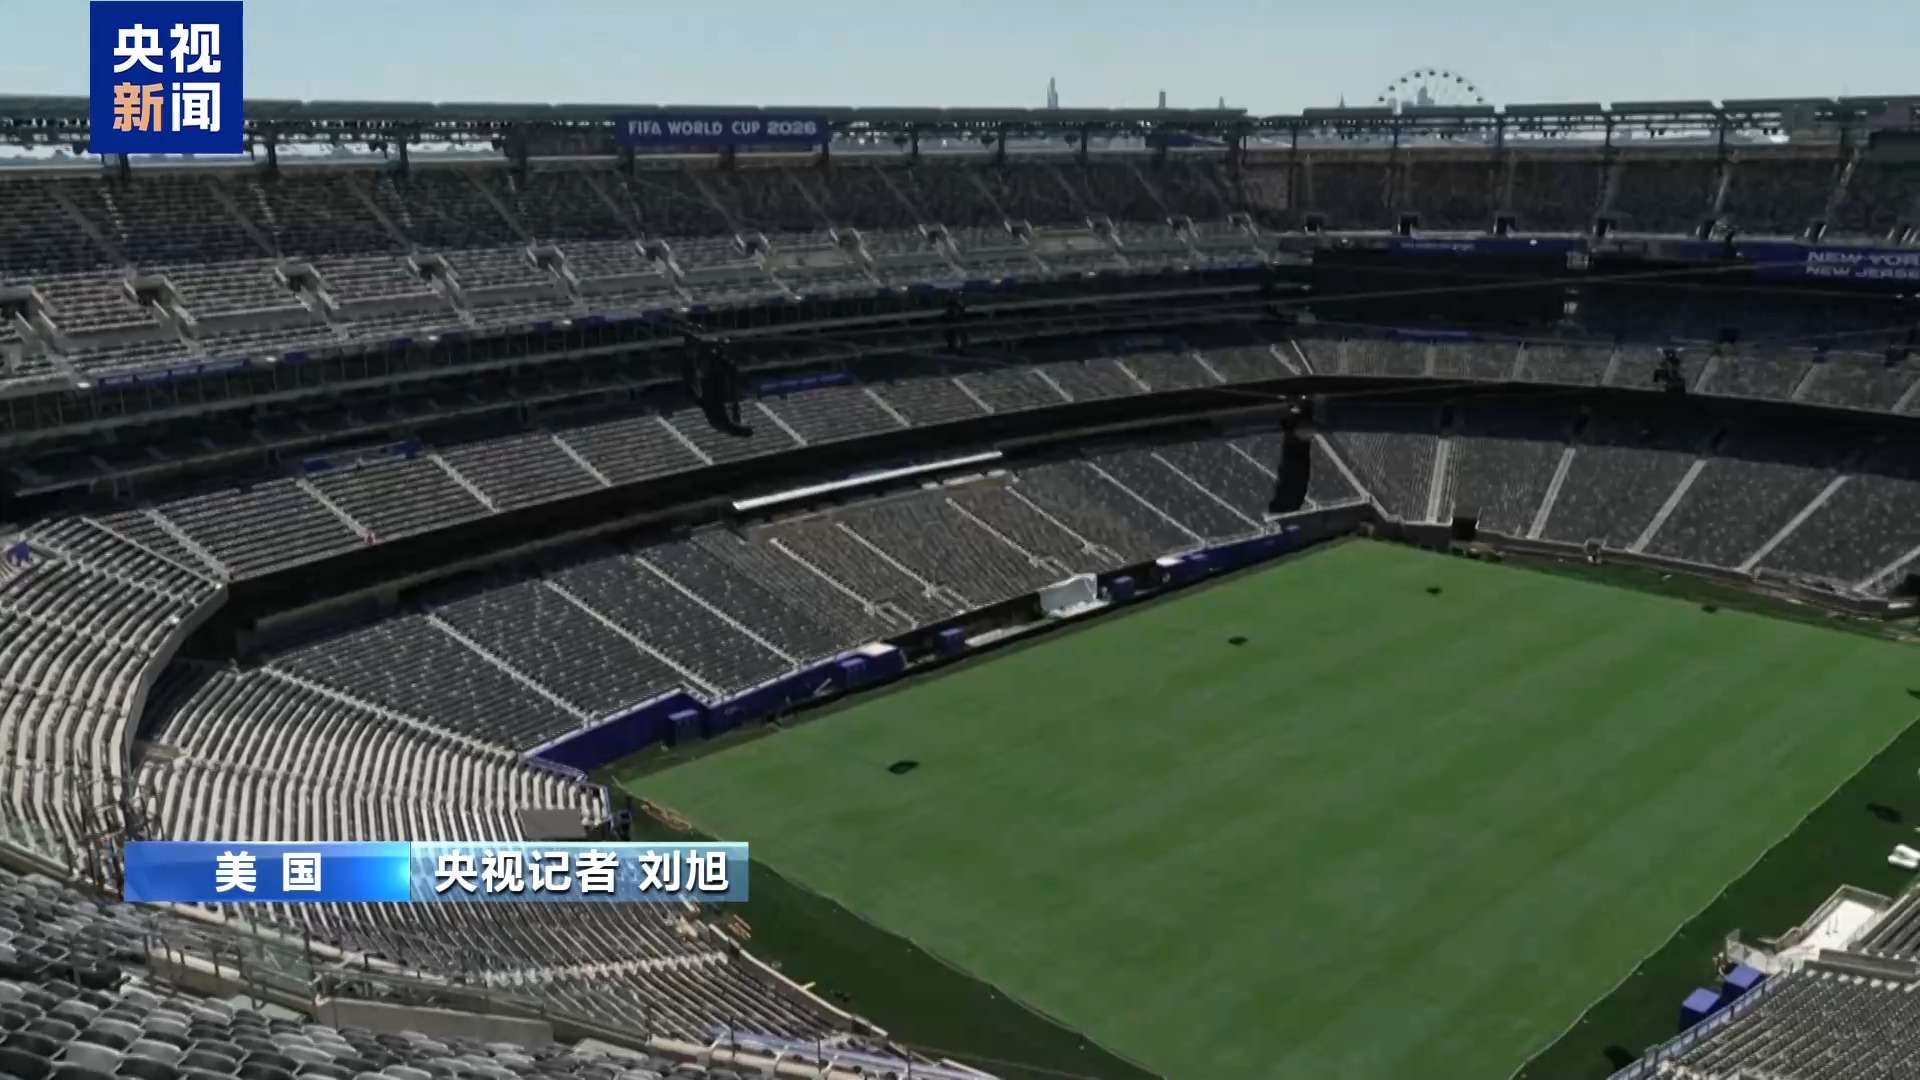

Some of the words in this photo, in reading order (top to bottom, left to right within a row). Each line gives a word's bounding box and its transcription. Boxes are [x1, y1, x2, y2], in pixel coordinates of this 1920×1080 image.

[628, 120, 662, 136] FIFA
[667, 120, 723, 136] WORLD
[731, 120, 761, 136] CUP
[766, 121, 817, 136] 2026
[1807, 251, 1861, 264] NEW
[1806, 266, 1850, 276] NEW
